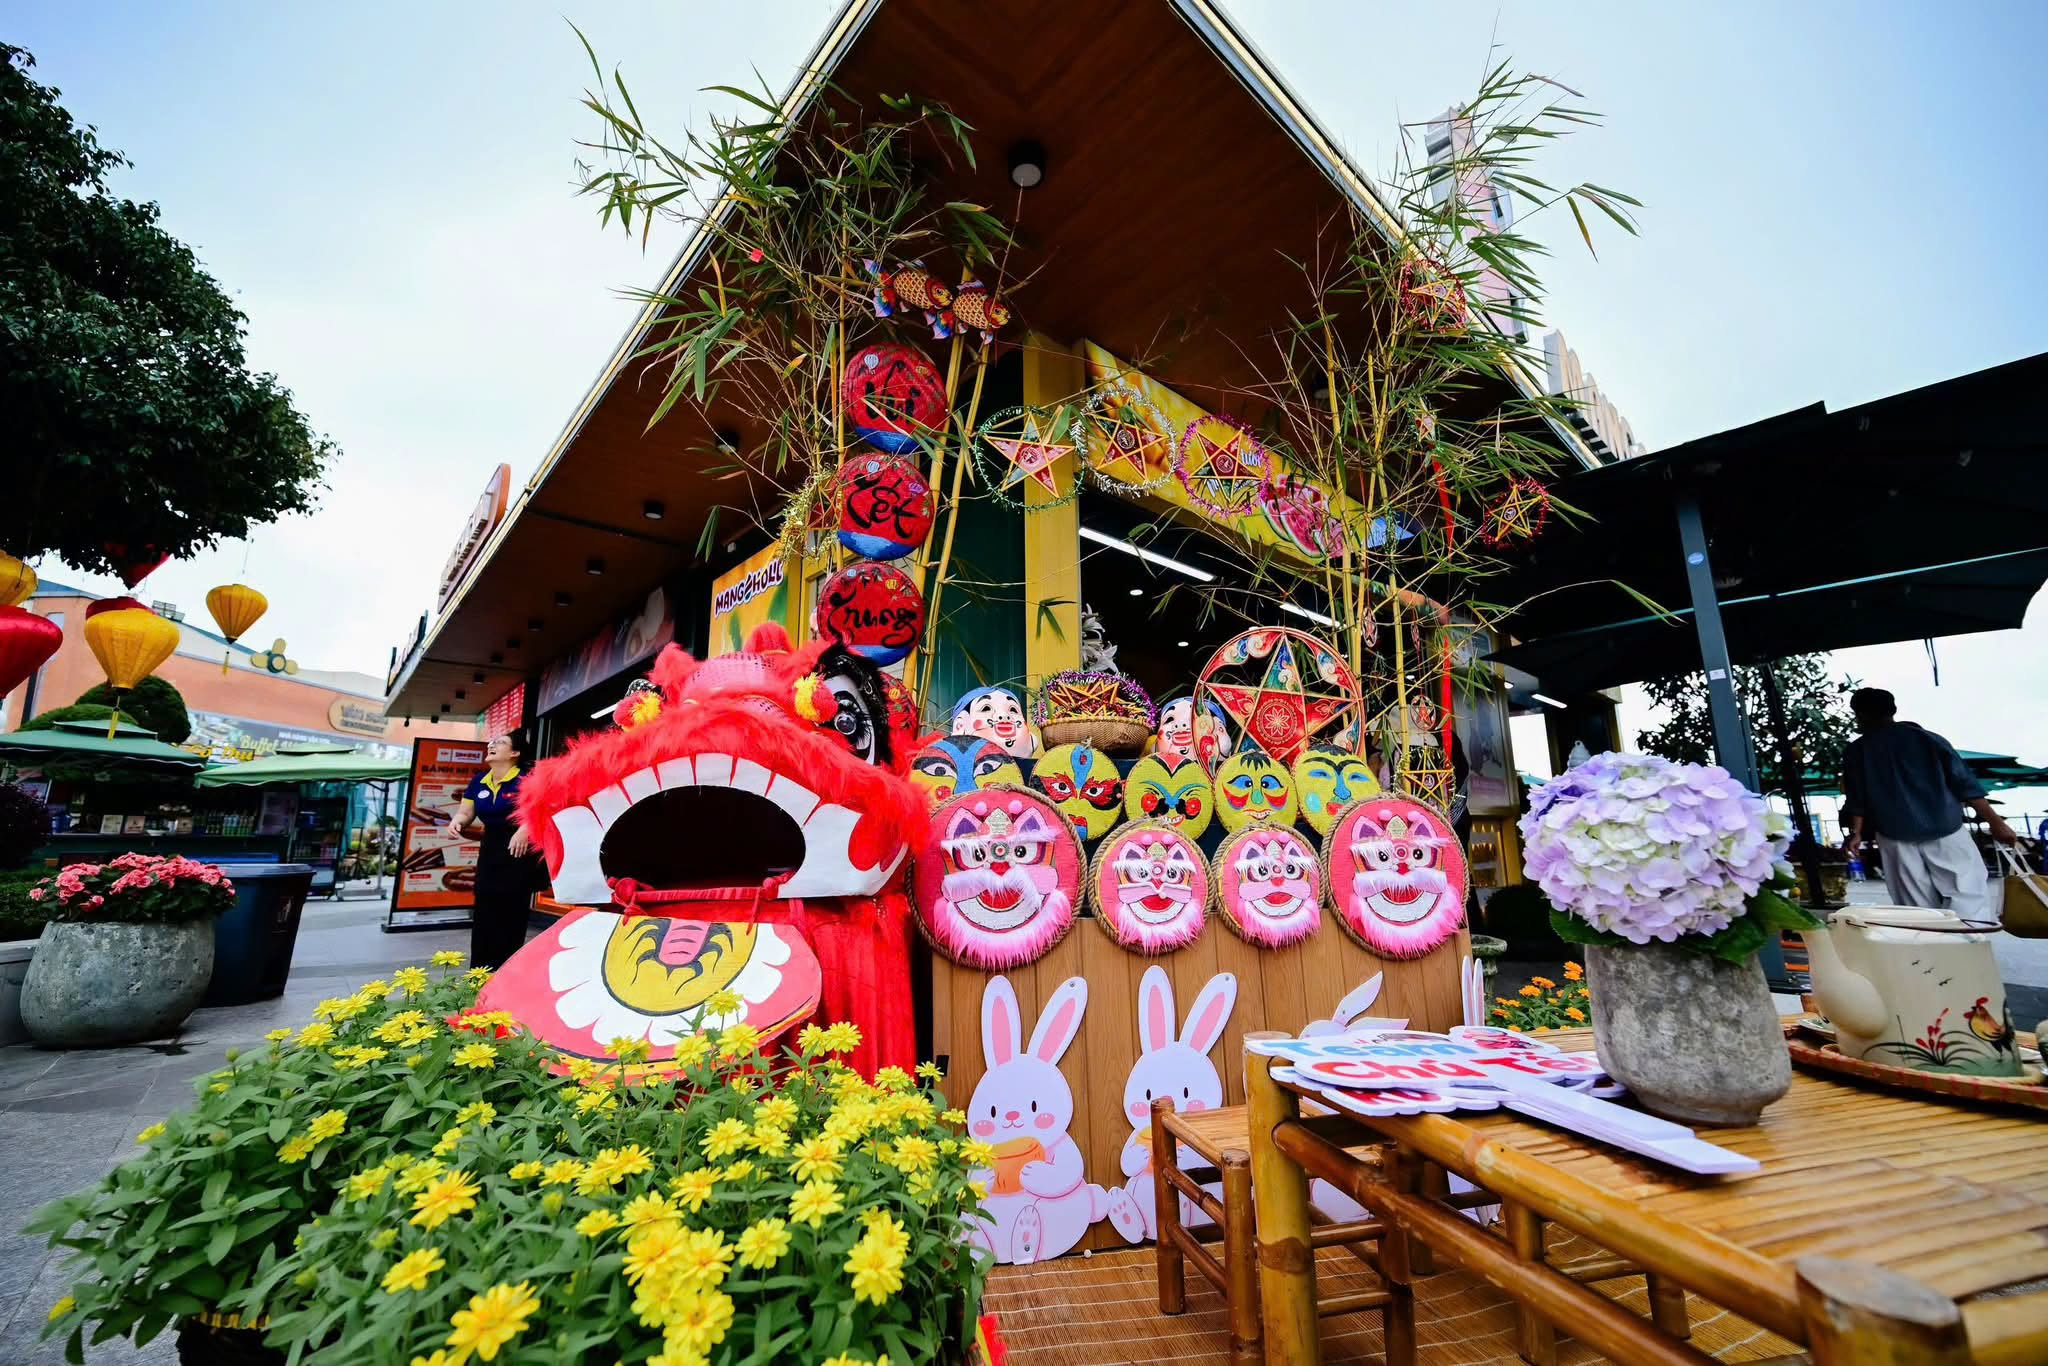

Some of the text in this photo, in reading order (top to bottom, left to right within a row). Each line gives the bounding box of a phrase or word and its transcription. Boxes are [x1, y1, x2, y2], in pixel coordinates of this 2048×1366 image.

[846, 473, 922, 539] Tết
[827, 587, 917, 648] Trung
[1261, 1042, 1478, 1057] Team
[1312, 1058, 1489, 1079] Chú
